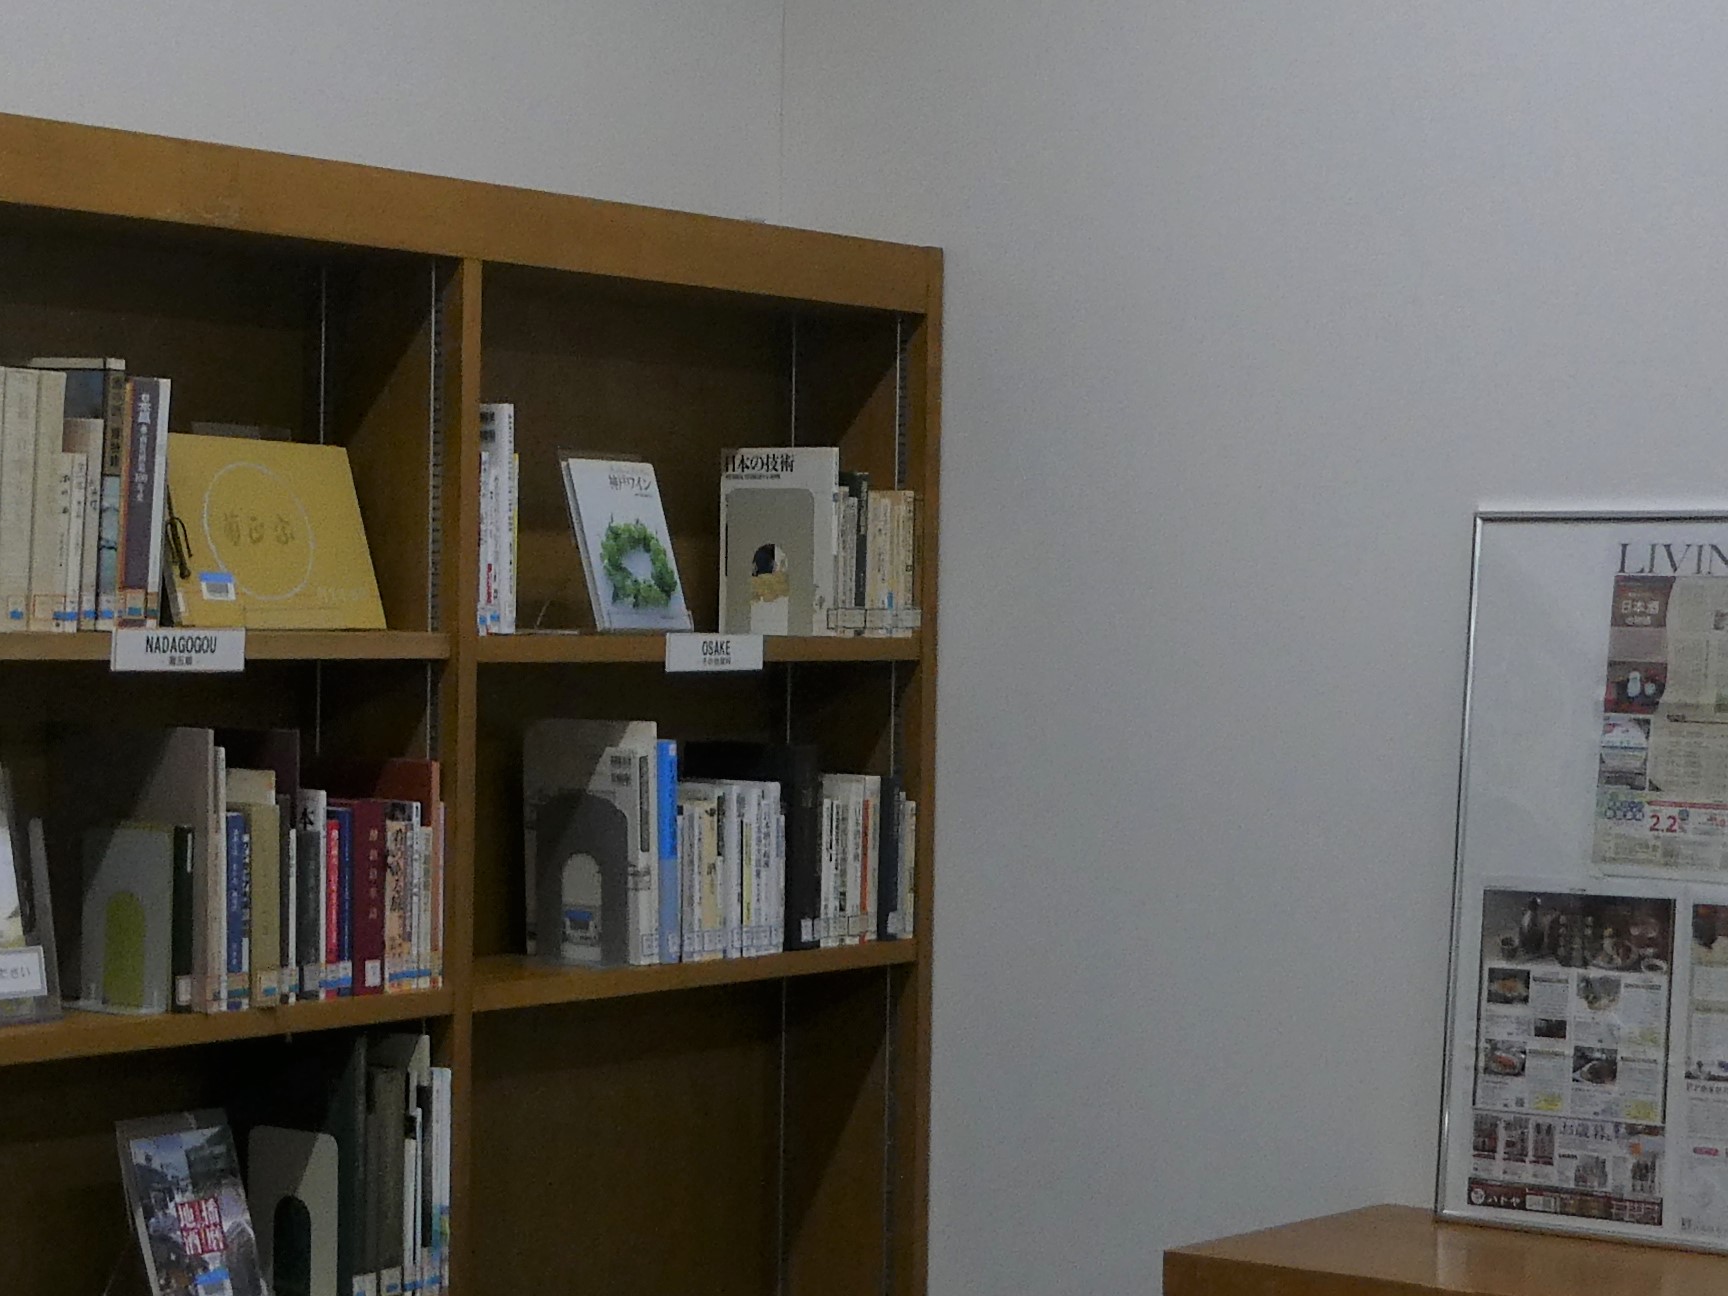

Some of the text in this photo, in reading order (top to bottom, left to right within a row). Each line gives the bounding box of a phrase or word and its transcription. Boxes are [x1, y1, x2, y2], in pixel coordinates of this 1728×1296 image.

[725, 454, 794, 472] 日本の技術
[608, 475, 652, 491] 神戸ワイン
[145, 636, 217, 654] NADAGOGOU
[702, 641, 731, 656] OSAKE
